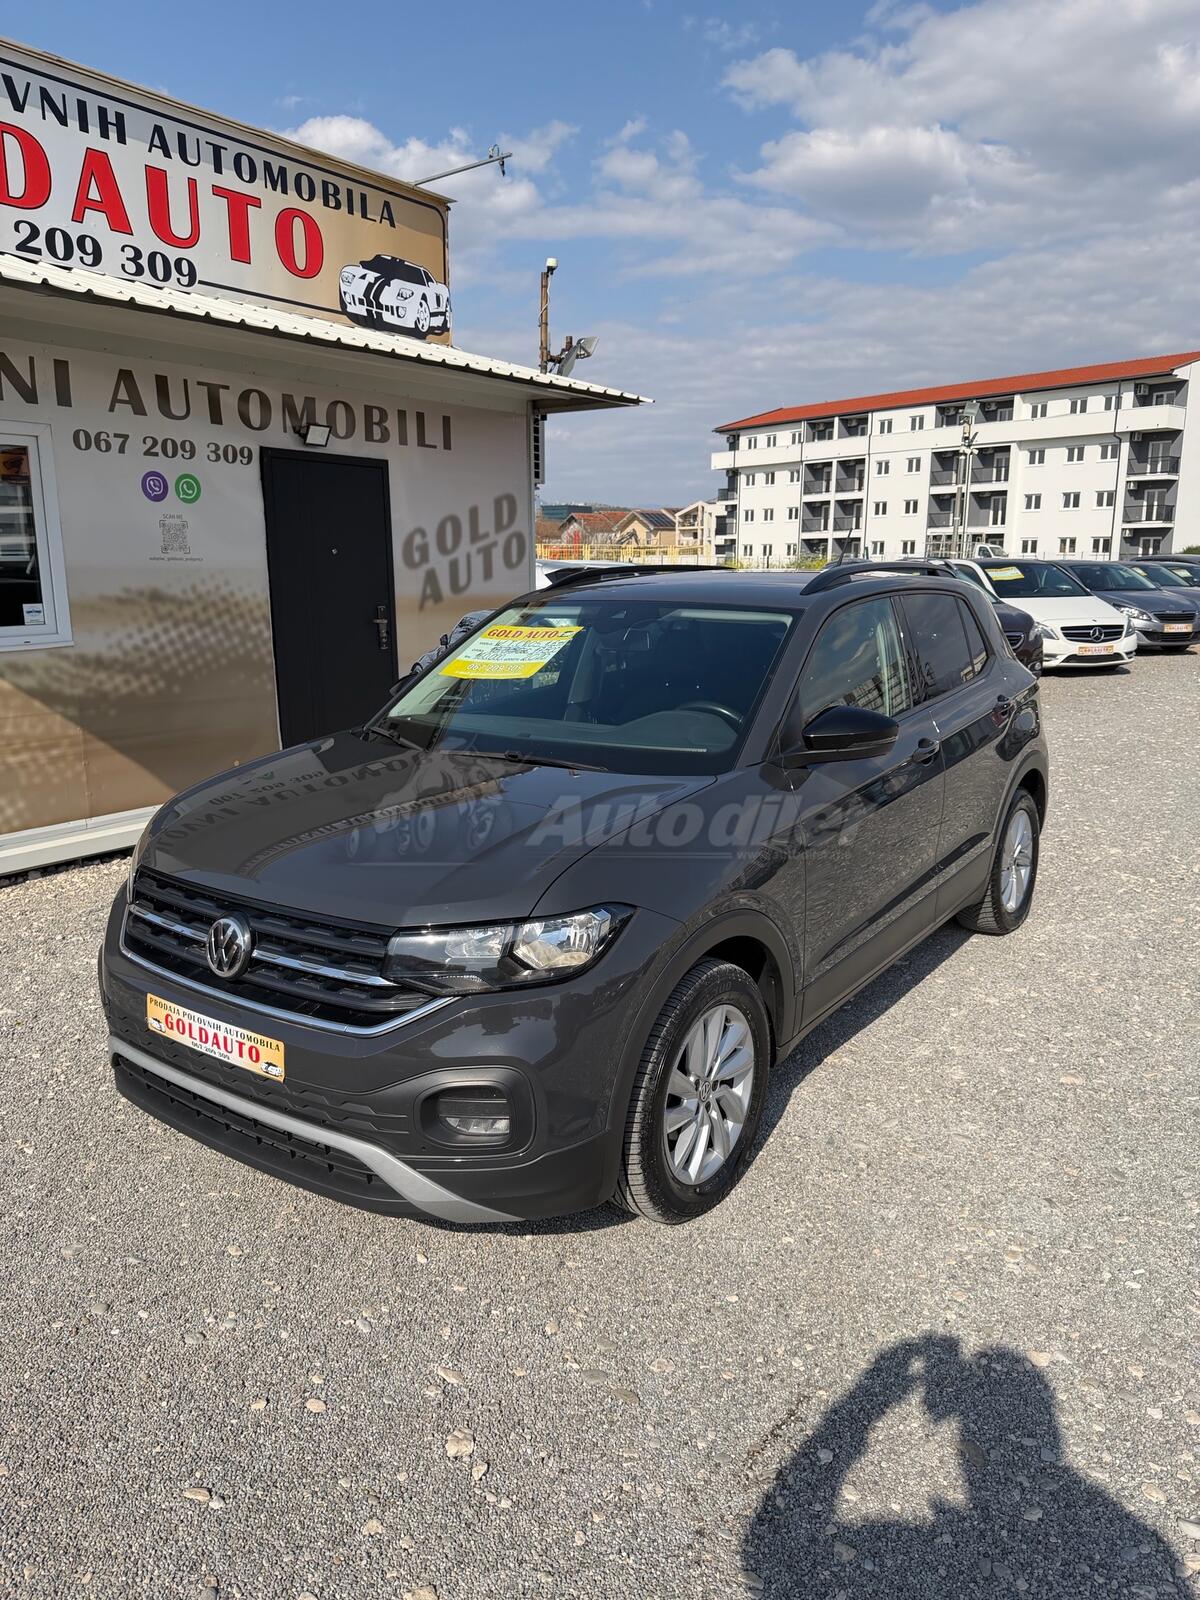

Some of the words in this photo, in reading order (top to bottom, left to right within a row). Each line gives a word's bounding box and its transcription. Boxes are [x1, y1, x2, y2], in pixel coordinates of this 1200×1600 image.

[1, 73, 127, 145] VNIH
[148, 124, 396, 228] AUTOMOBILA
[14, 219, 103, 268] 209
[120, 244, 198, 288] 309
[0, 353, 73, 408] NI
[108, 368, 452, 451] AUTOMOBILI
[72, 428, 128, 454] 067
[142, 436, 197, 460] 209
[206, 442, 254, 466] 309
[402, 493, 518, 571] GOLD
[419, 530, 526, 612] AUTO
[487, 628, 522, 639] GOLD
[523, 630, 558, 639] AUTO
[149, 997, 181, 1017] PRODAJA
[182, 1011, 221, 1032] POLOVNIH
[224, 1026, 281, 1052] AUTOMOBILA
[164, 1013, 261, 1063] GOLDAUTO
